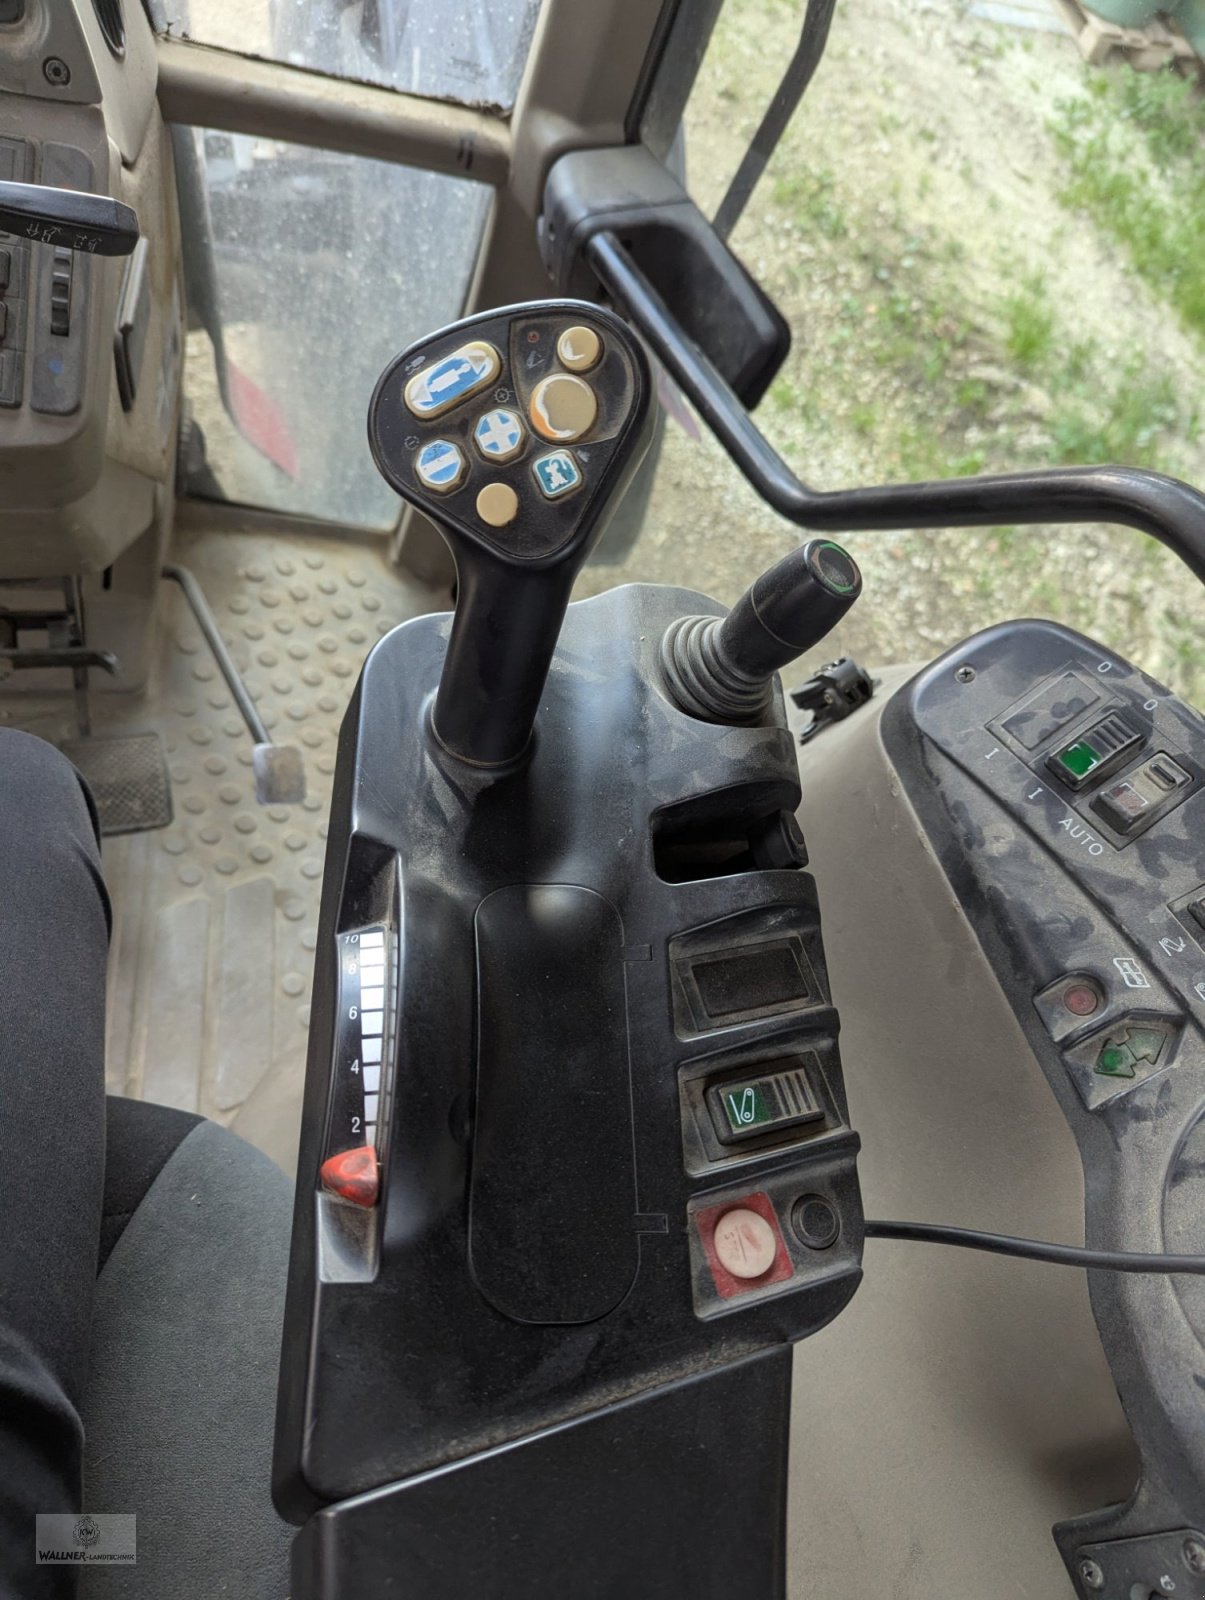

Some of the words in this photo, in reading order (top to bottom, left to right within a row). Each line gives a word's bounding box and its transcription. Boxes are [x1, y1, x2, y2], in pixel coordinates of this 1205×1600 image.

[1058, 818, 1104, 856] AUTO
[344, 934, 359, 944] 10
[347, 963, 357, 975] 8
[348, 1006, 358, 1020] 6
[350, 1059, 360, 1075] 4
[351, 1117, 361, 1133] 2
